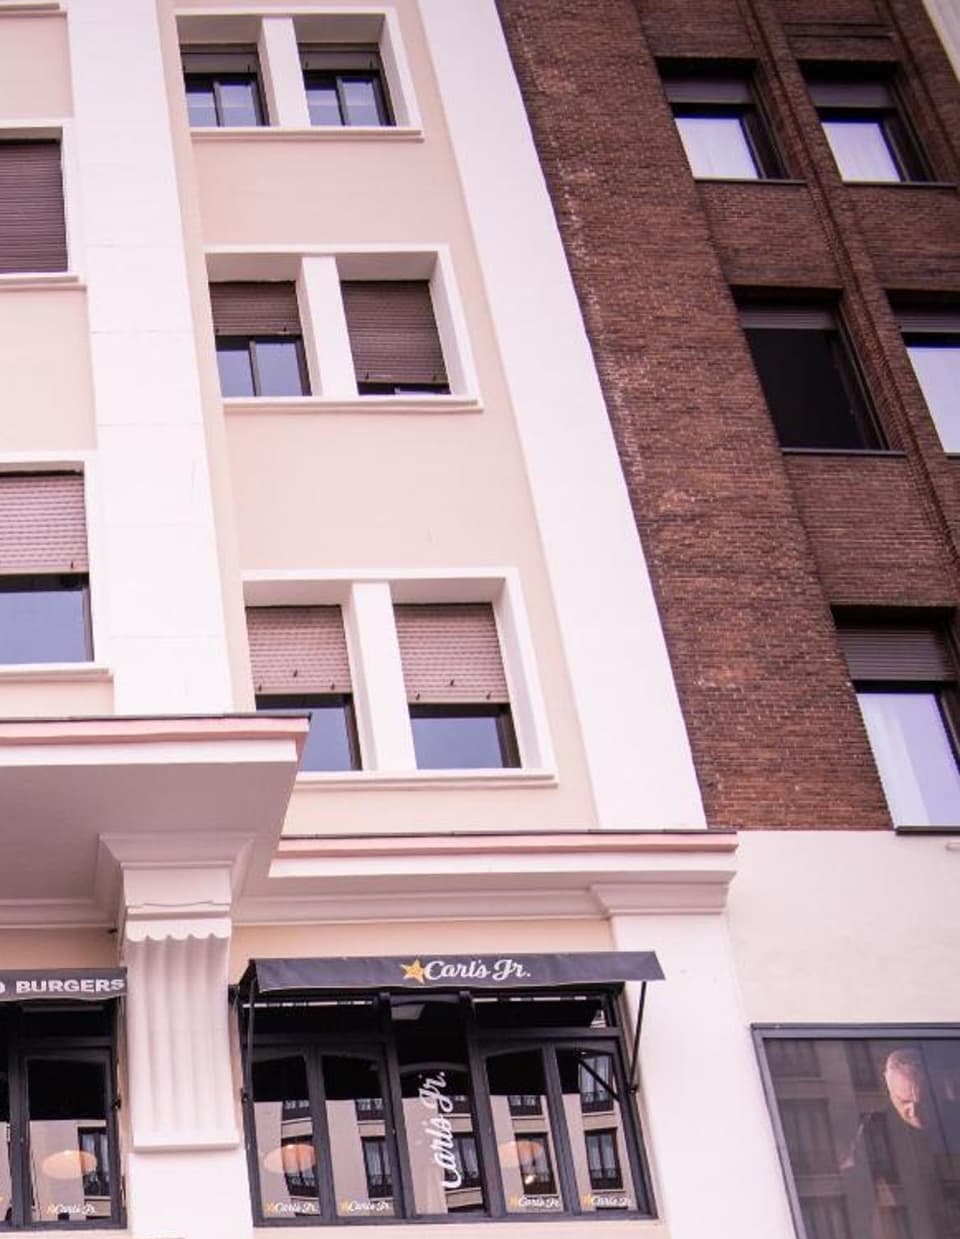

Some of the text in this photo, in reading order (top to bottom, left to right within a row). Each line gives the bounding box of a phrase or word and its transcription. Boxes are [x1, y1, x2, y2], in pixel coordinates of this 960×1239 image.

[424, 959, 531, 981] Carl's Jr.
[15, 977, 126, 995] BURGERS
[418, 1072, 453, 1112] Jr.
